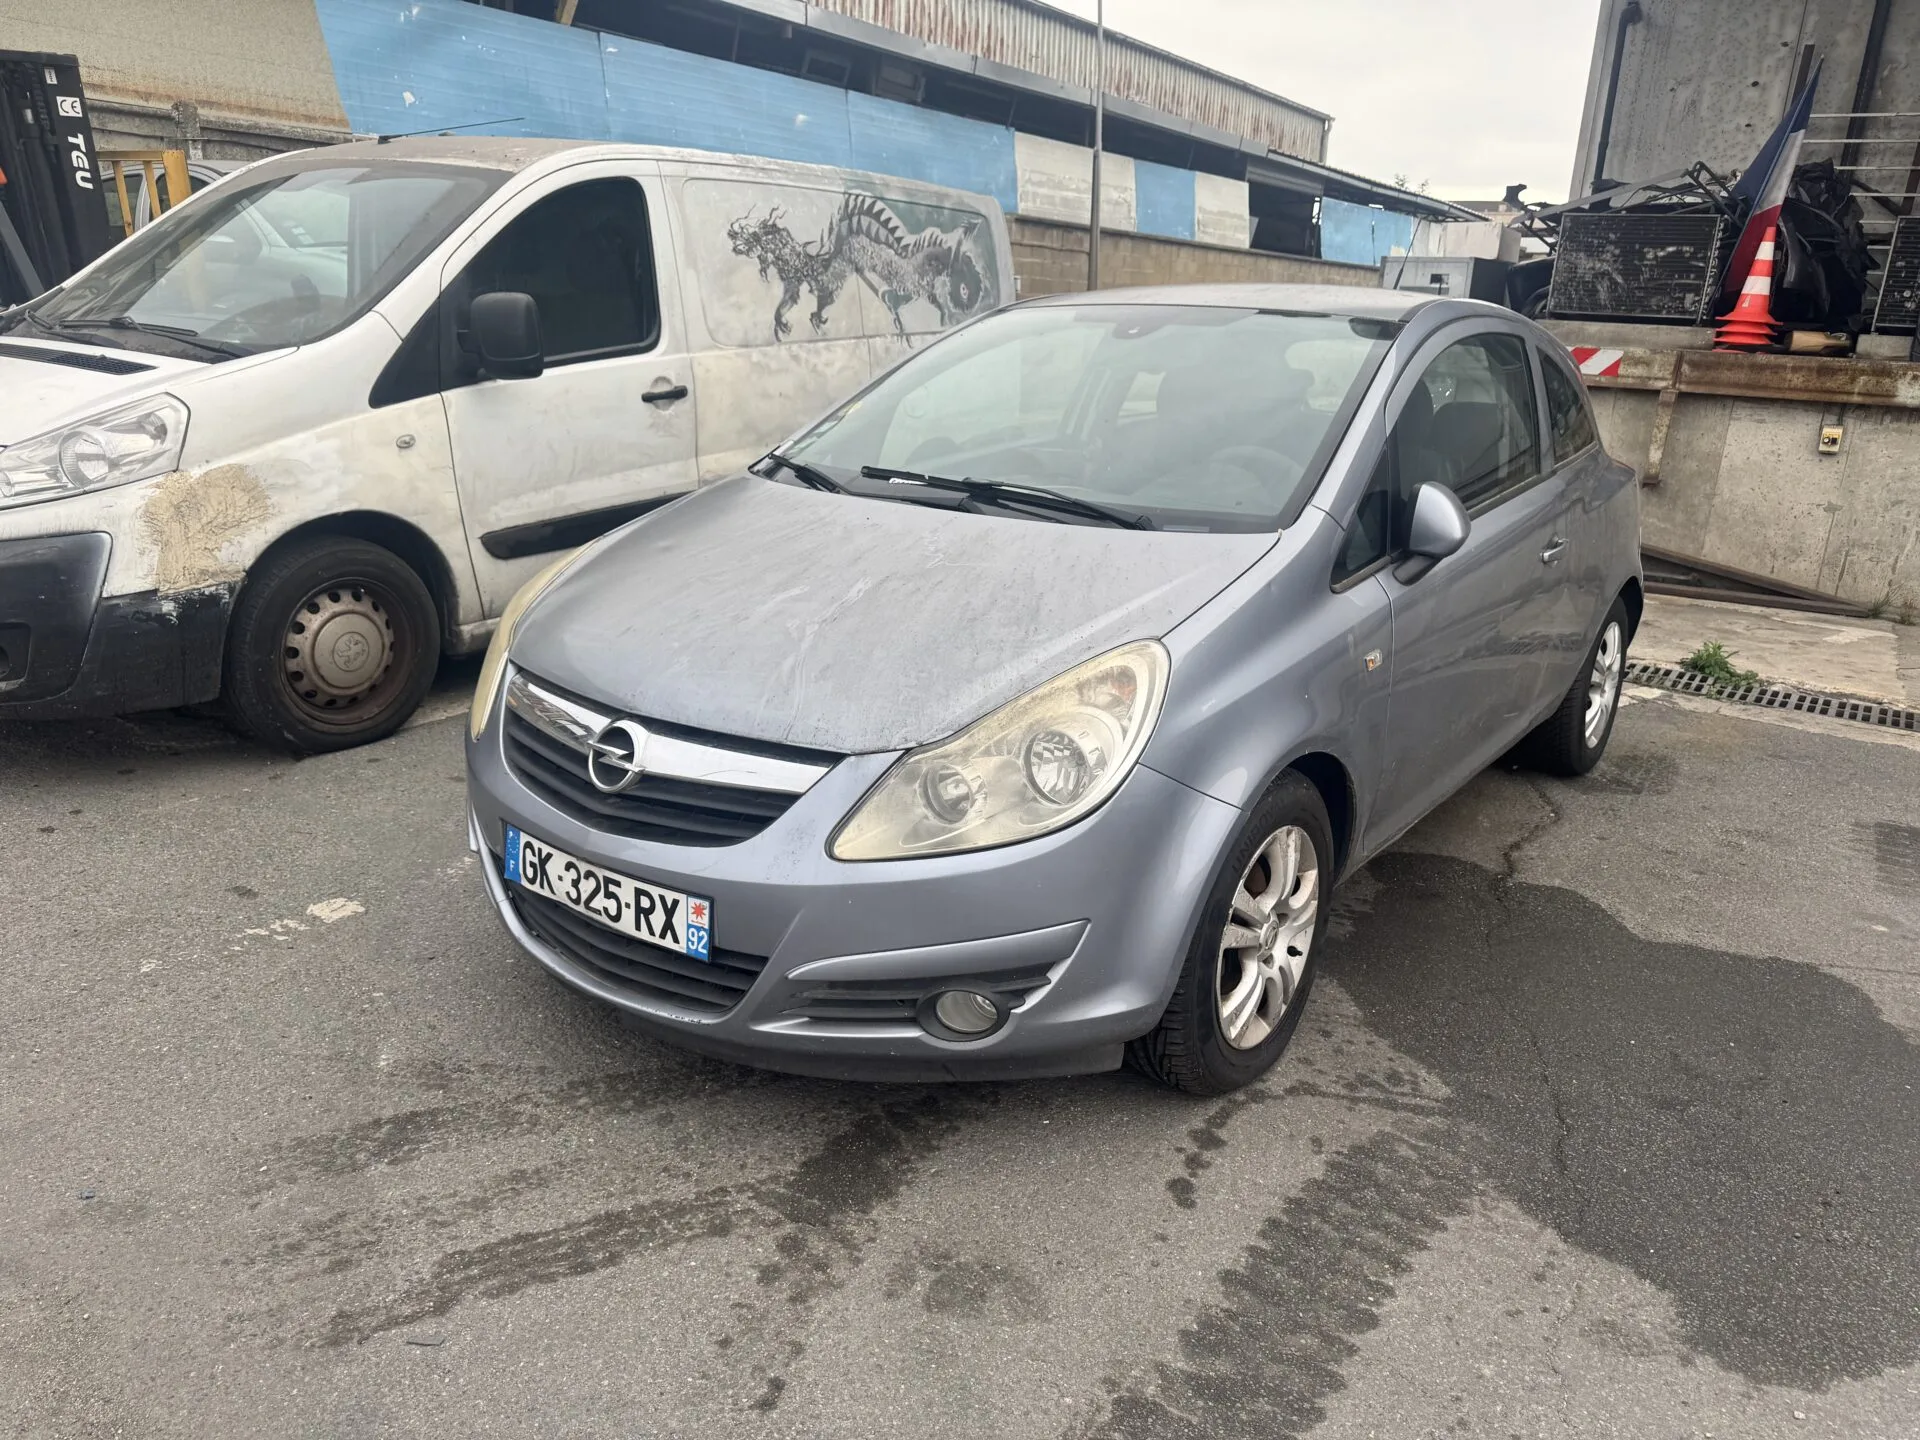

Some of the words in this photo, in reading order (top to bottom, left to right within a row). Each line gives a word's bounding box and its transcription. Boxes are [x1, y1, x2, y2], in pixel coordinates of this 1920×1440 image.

[60, 99, 81, 115] CE
[509, 859, 516, 872] F
[521, 840, 681, 945] GK-325-RX
[687, 927, 708, 954] 92
